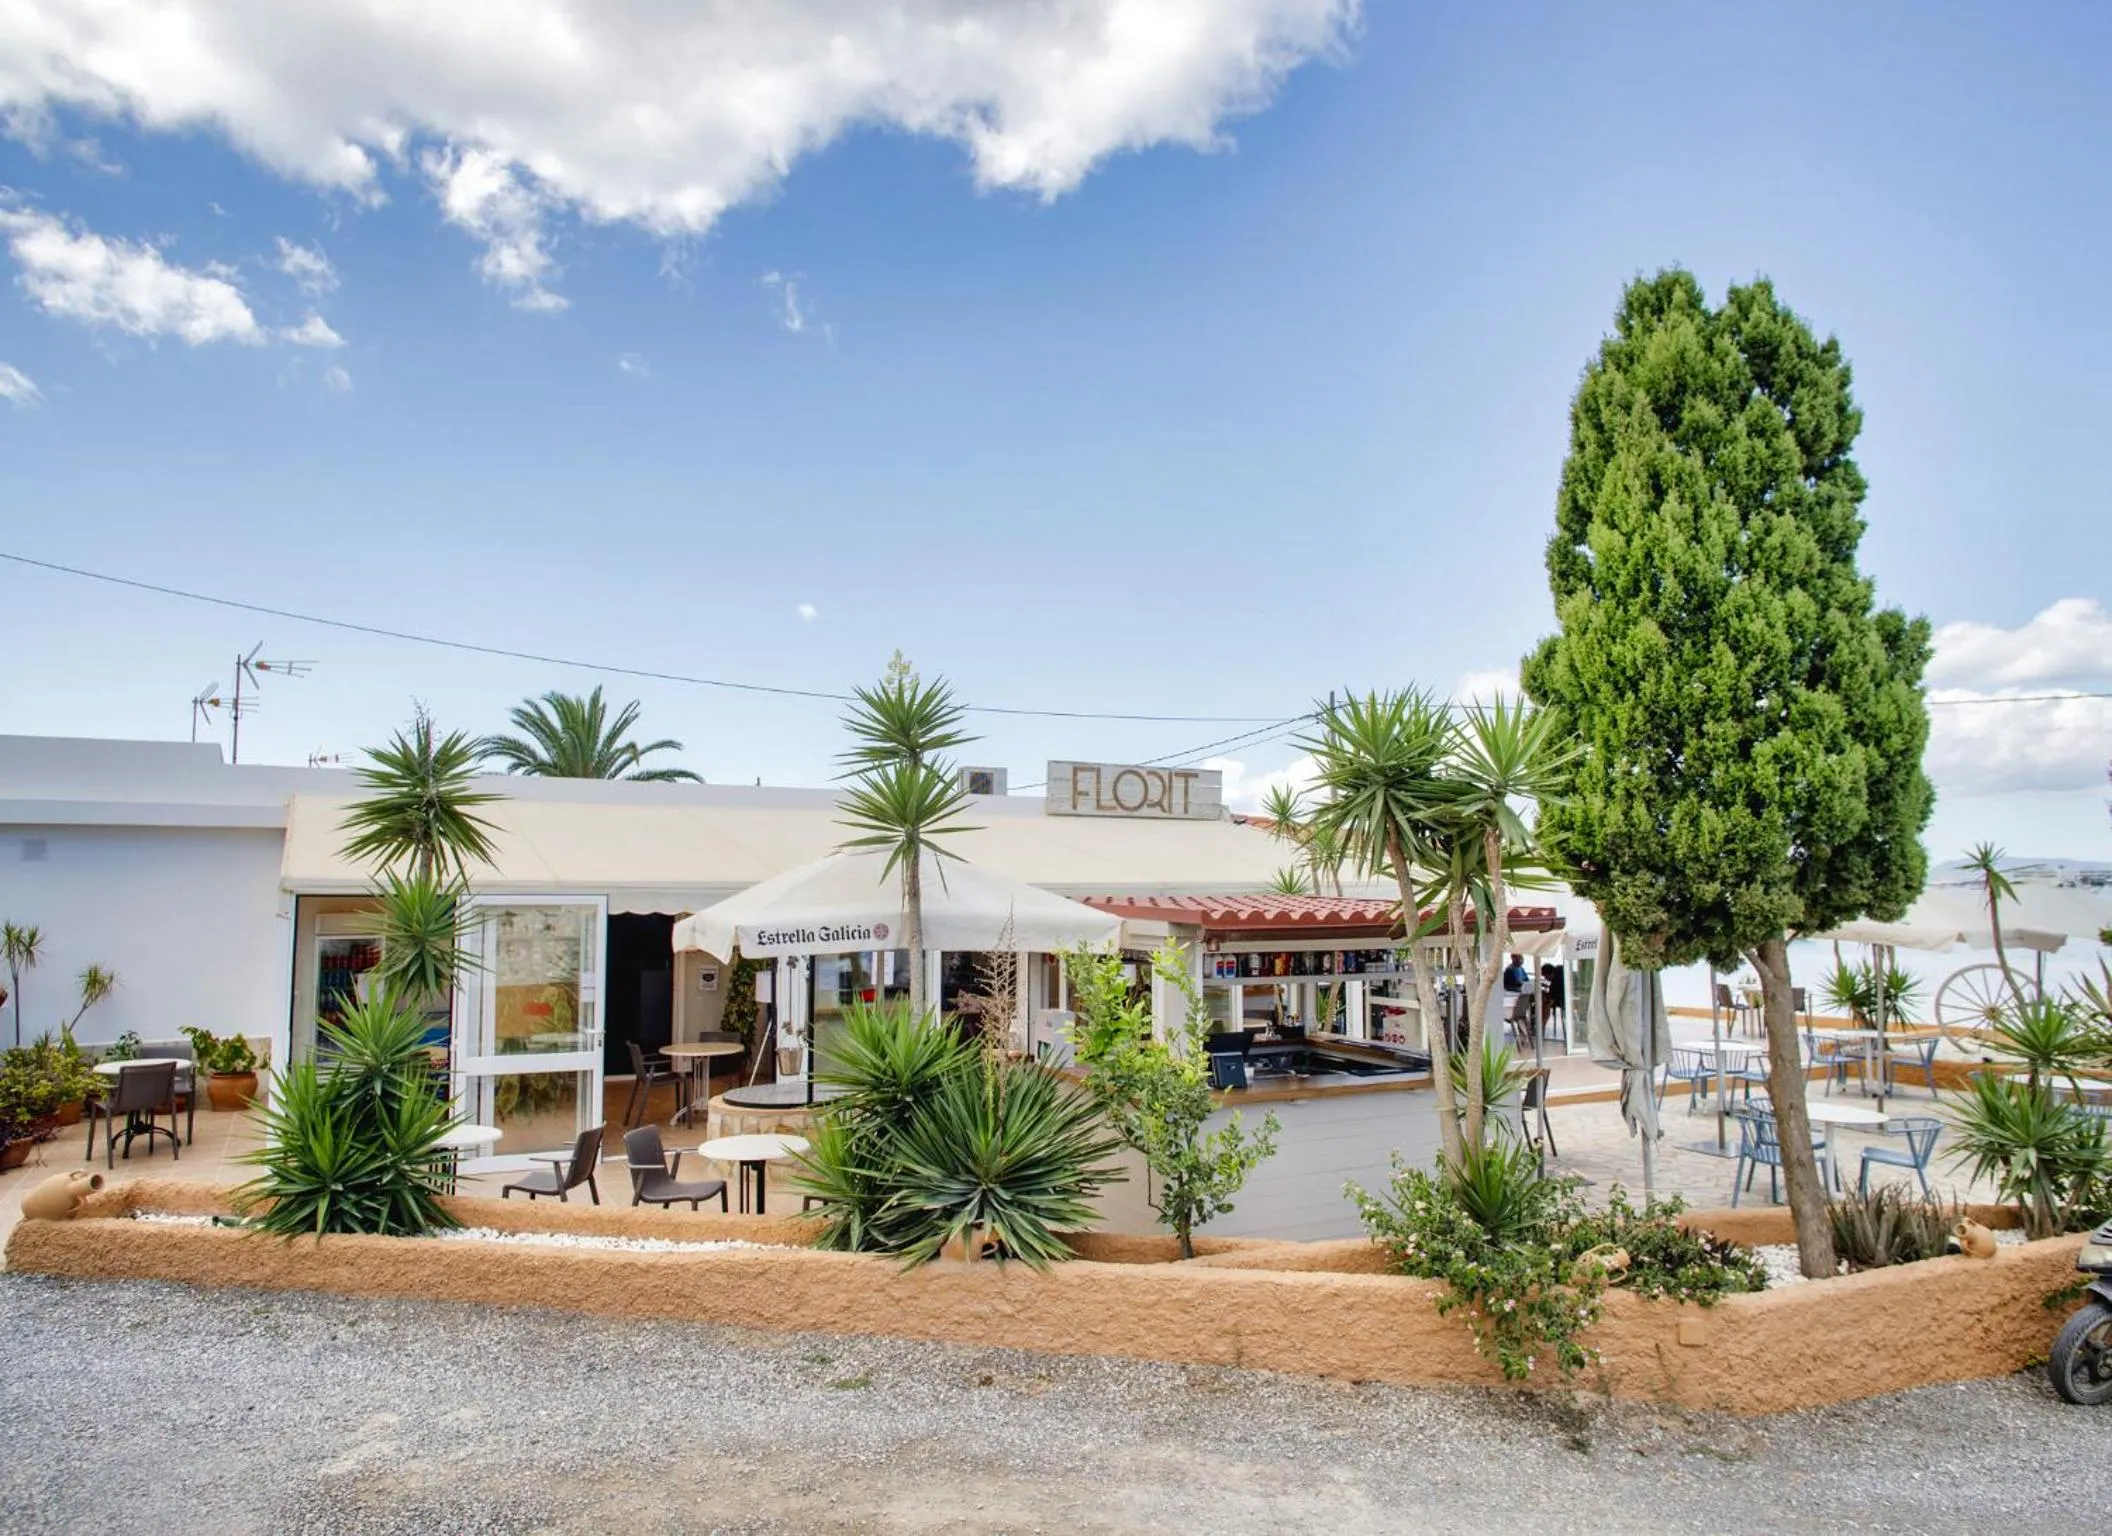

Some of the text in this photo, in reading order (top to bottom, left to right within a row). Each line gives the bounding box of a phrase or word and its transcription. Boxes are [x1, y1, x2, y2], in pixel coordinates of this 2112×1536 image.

[1072, 766, 1199, 814] FLORIT
[757, 925, 871, 946] Estrella Galicia
